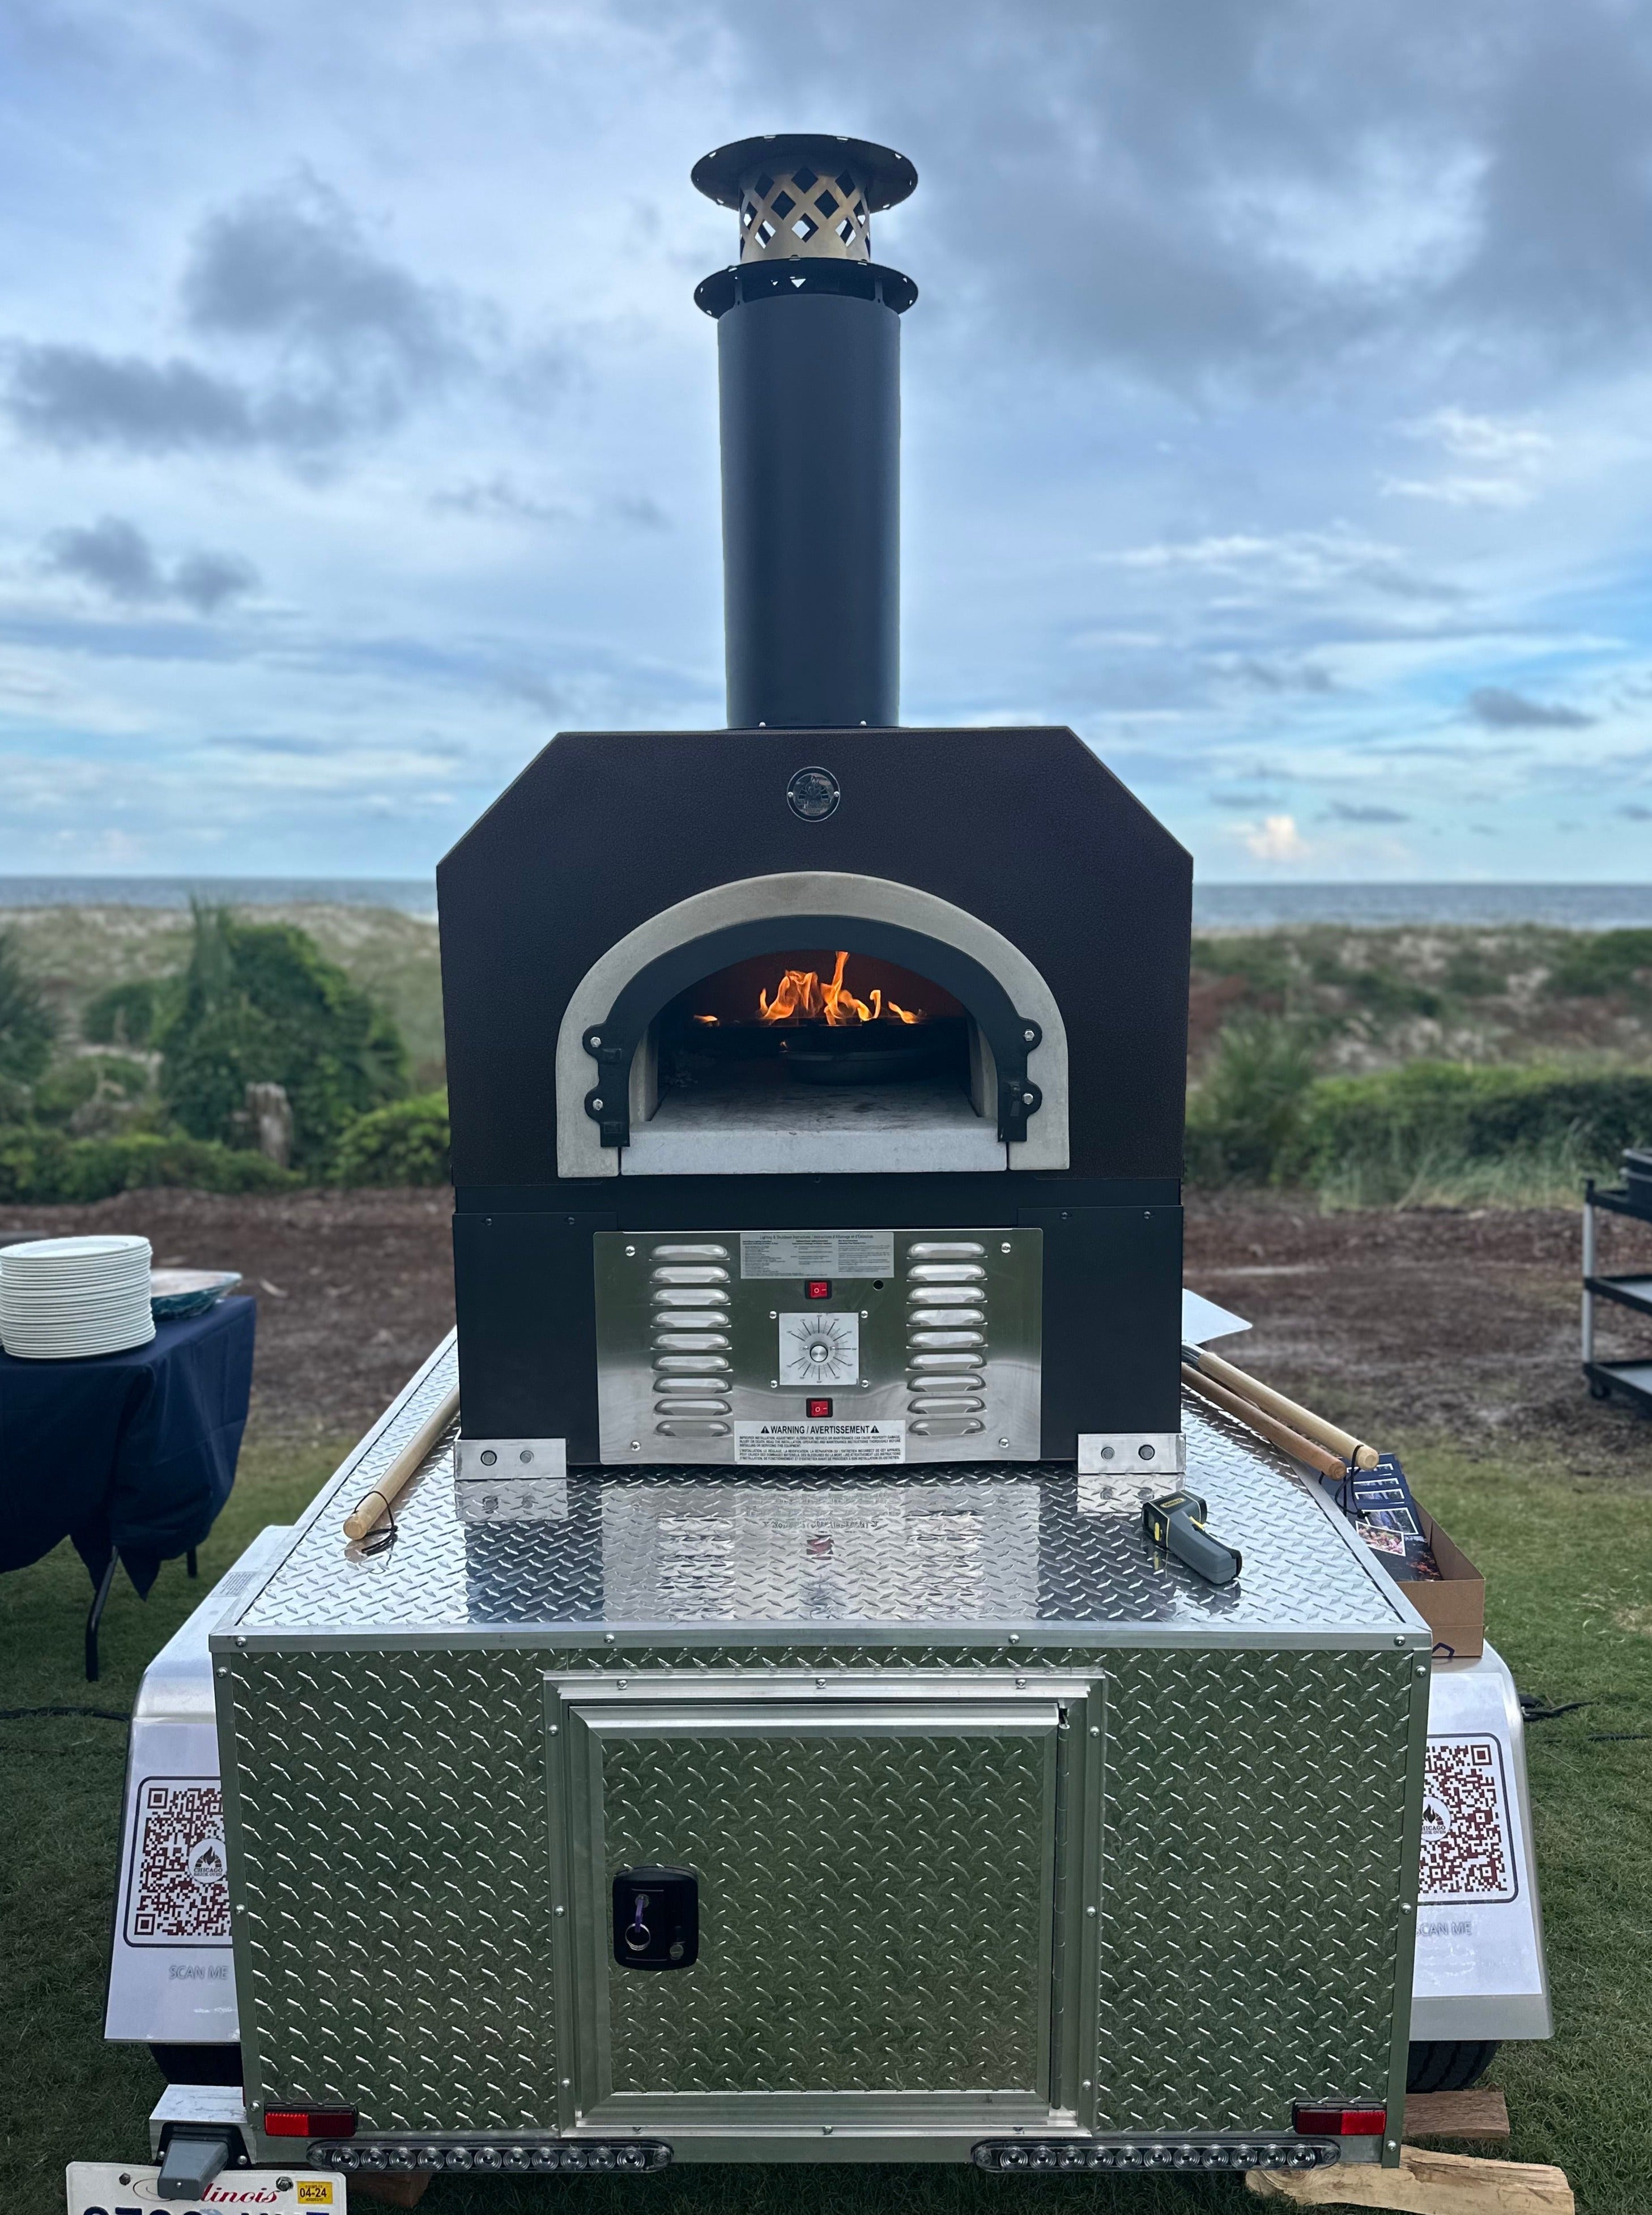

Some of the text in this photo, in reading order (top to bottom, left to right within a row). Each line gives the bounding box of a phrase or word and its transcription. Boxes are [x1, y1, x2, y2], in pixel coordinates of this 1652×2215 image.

[1450, 1920, 1472, 1936] ME
[169, 1965, 229, 1980] SCAN ME
[199, 2183, 280, 2203] linois
[300, 2188, 327, 2197] 04-24
